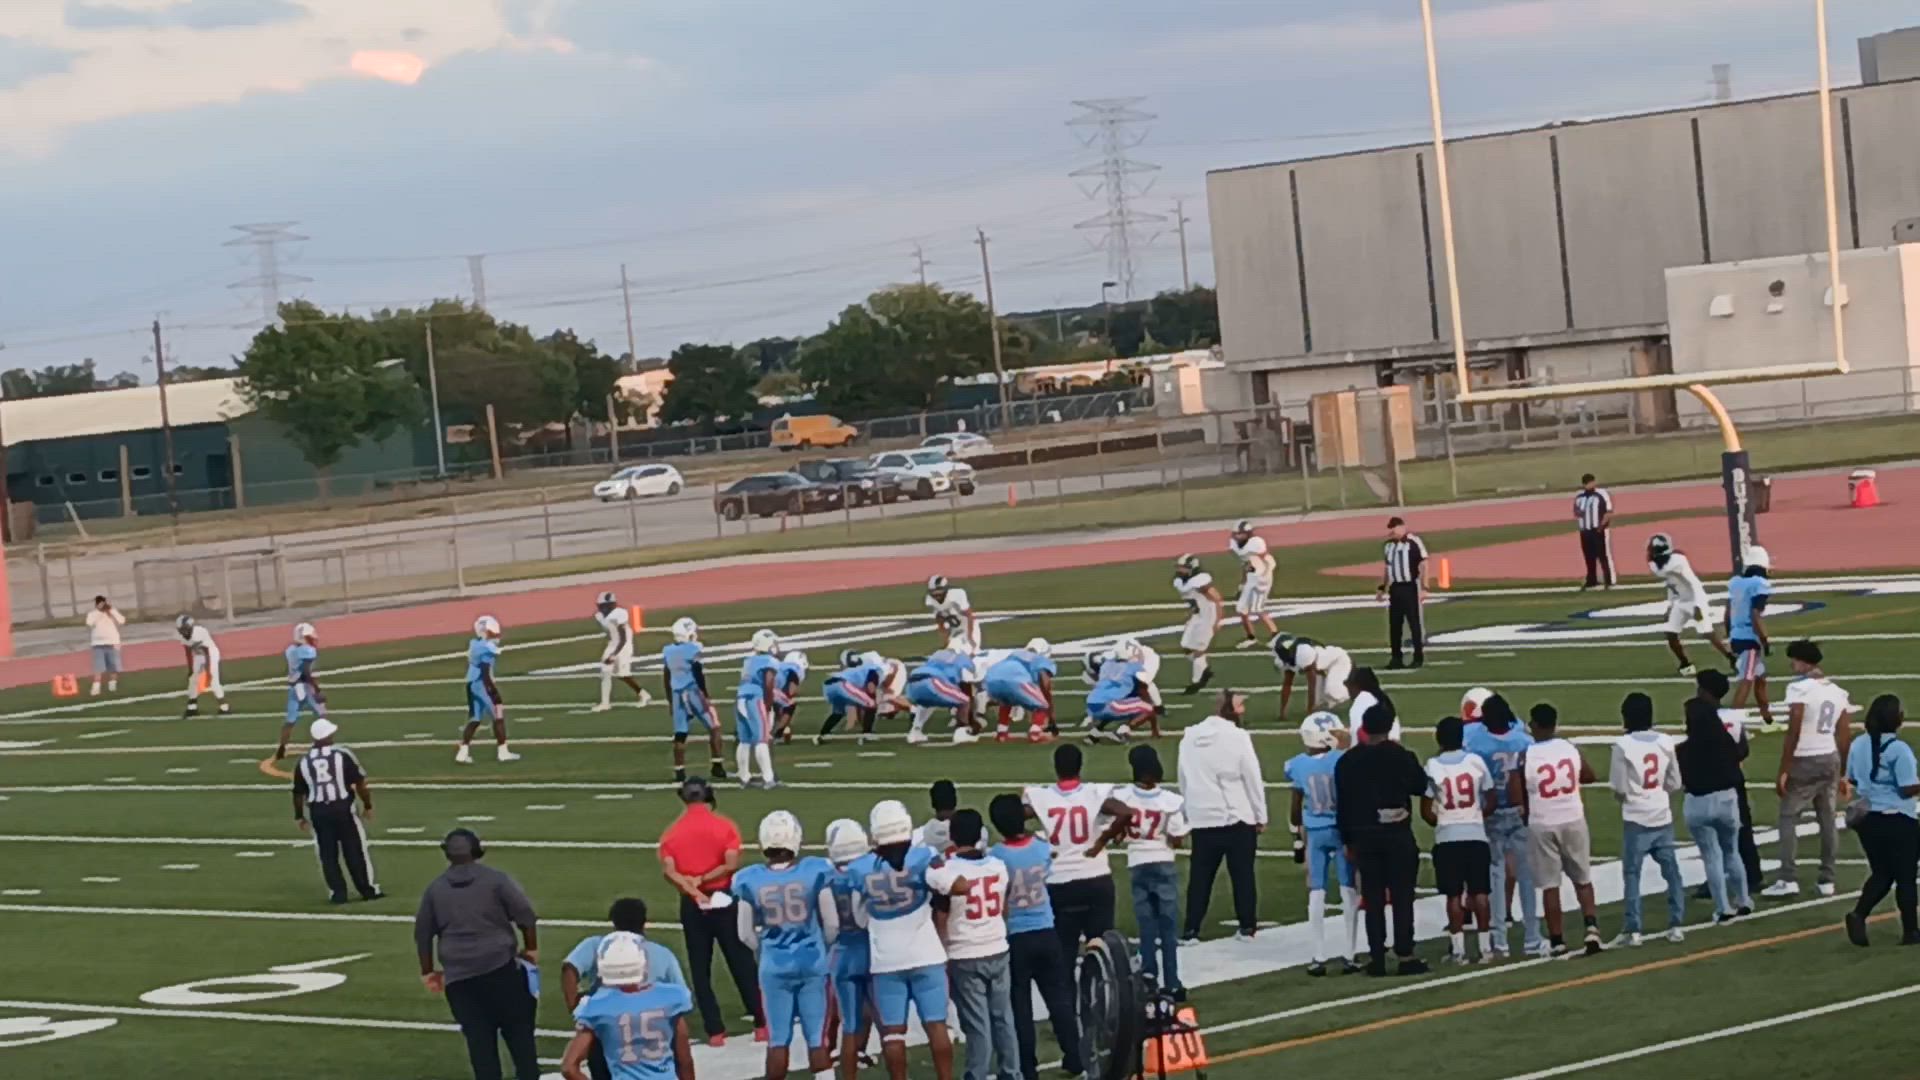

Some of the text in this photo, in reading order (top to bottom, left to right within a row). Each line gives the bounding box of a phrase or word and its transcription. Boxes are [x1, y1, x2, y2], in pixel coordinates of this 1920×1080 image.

[1443, 772, 1476, 811] 19
[1537, 757, 1577, 799] 23
[1642, 752, 1660, 790] 2
[1047, 805, 1090, 846] 70
[757, 880, 809, 926] 56
[865, 870, 914, 911] 55
[964, 874, 1001, 921] 55
[616, 1009, 668, 1065] 15
